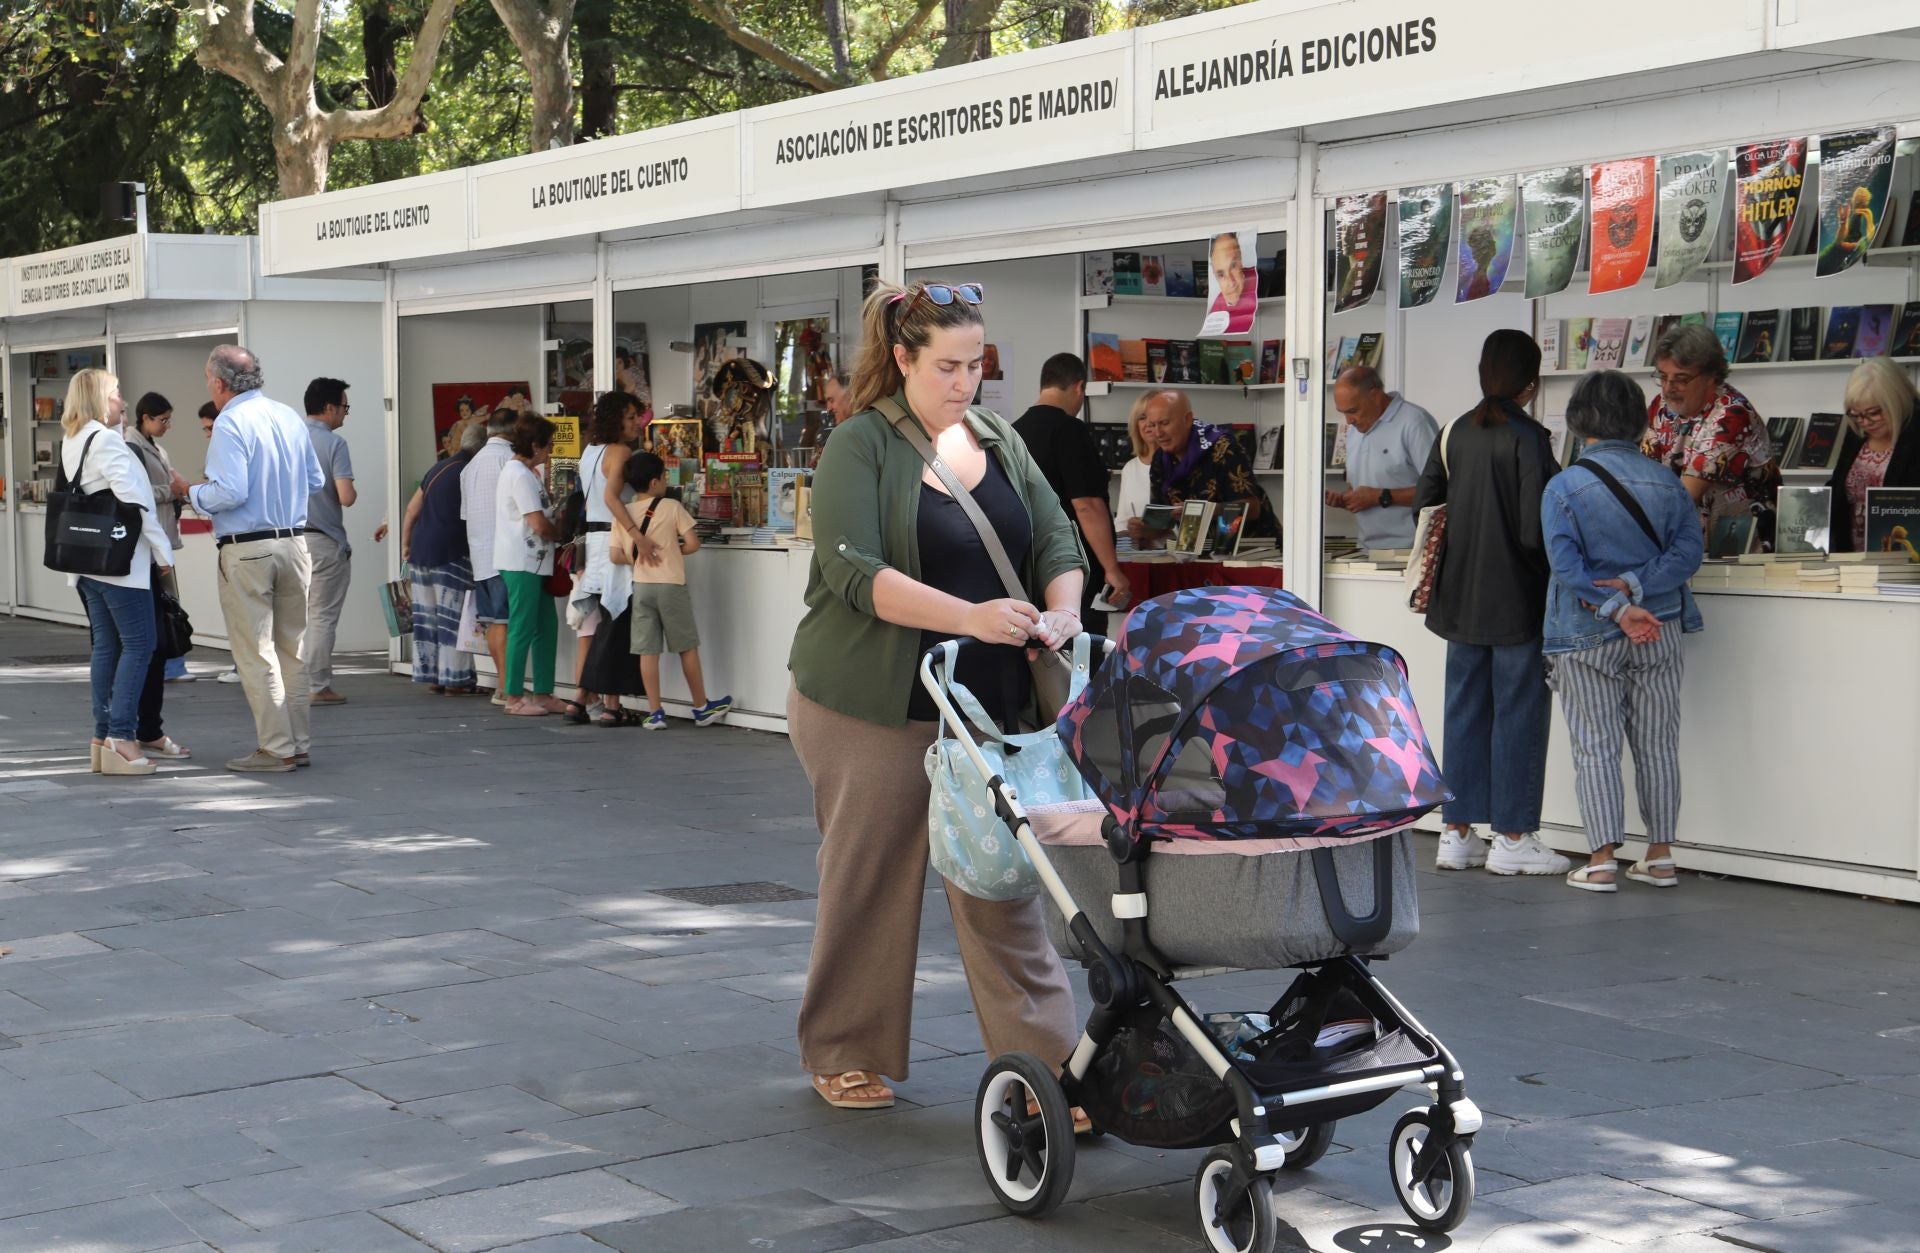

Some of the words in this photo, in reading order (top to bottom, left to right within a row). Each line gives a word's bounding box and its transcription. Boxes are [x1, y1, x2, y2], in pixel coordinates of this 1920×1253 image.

[1155, 39, 1294, 100] ALEJANDRÍA
[1302, 17, 1437, 74] EDICIONES
[776, 120, 867, 165] ASOCIACIÓN
[873, 120, 893, 149] DE
[898, 99, 1003, 145] ESCRITORES
[1009, 94, 1032, 125] DE
[1745, 151, 1765, 162] OLGA
[533, 186, 546, 209] LA
[549, 173, 607, 206] BOUTIQUE
[611, 169, 633, 194] DEL
[637, 157, 688, 189] CUENTO
[1674, 163, 1715, 180] BRAM
[1744, 174, 1801, 195] HORNOS
[317, 221, 327, 240] LA
[329, 214, 372, 238] BOUTIQUE
[375, 211, 390, 232] DEL
[393, 204, 430, 229] CUENTO
[1742, 197, 1796, 223] HITLER
[22, 264, 48, 281] INSTITUTO
[50, 257, 83, 277] CASTELLANO
[85, 255, 89, 271] Y
[114, 249, 121, 266] DE
[123, 247, 130, 264] LA
[44, 282, 69, 301] EDITORES
[72, 280, 79, 297] DE
[81, 276, 107, 295] CASTILLA
[108, 275, 112, 291] Y
[1872, 506, 1879, 514] El
